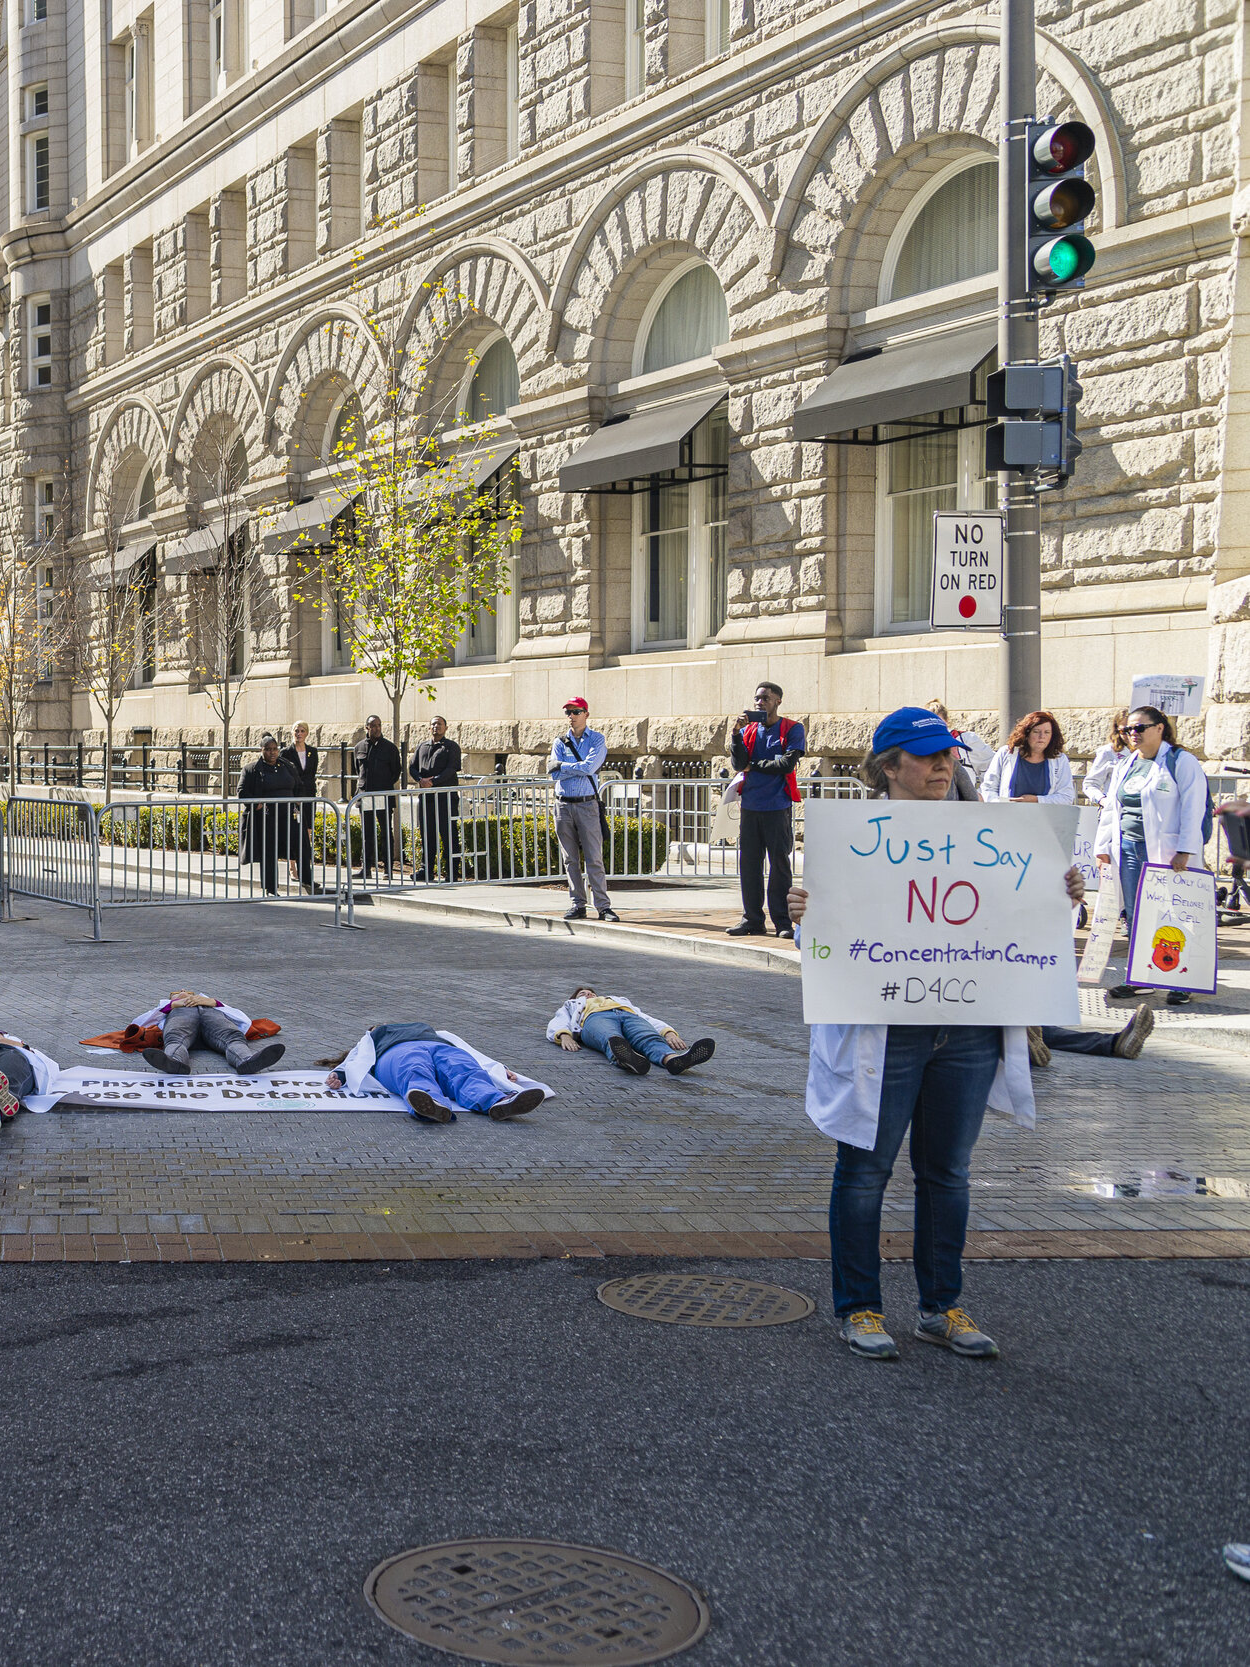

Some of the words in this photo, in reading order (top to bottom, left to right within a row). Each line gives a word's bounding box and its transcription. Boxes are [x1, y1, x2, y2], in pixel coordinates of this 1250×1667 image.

[955, 524, 983, 544] NO
[950, 551, 989, 567] TURN
[940, 574, 960, 590] ON
[968, 574, 997, 590] RED
[850, 815, 956, 864] Just
[973, 828, 1033, 891] Say
[907, 876, 980, 925] NO
[1161, 909, 1172, 922] A
[1178, 910, 1201, 924] CELL
[807, 937, 832, 960] to
[849, 938, 1059, 970] #ConcentrationCamps
[880, 977, 978, 1004] #D4CC
[82, 1079, 258, 1088] Physicians'
[51, 1090, 142, 1100] ose
[154, 1090, 209, 1099] the
